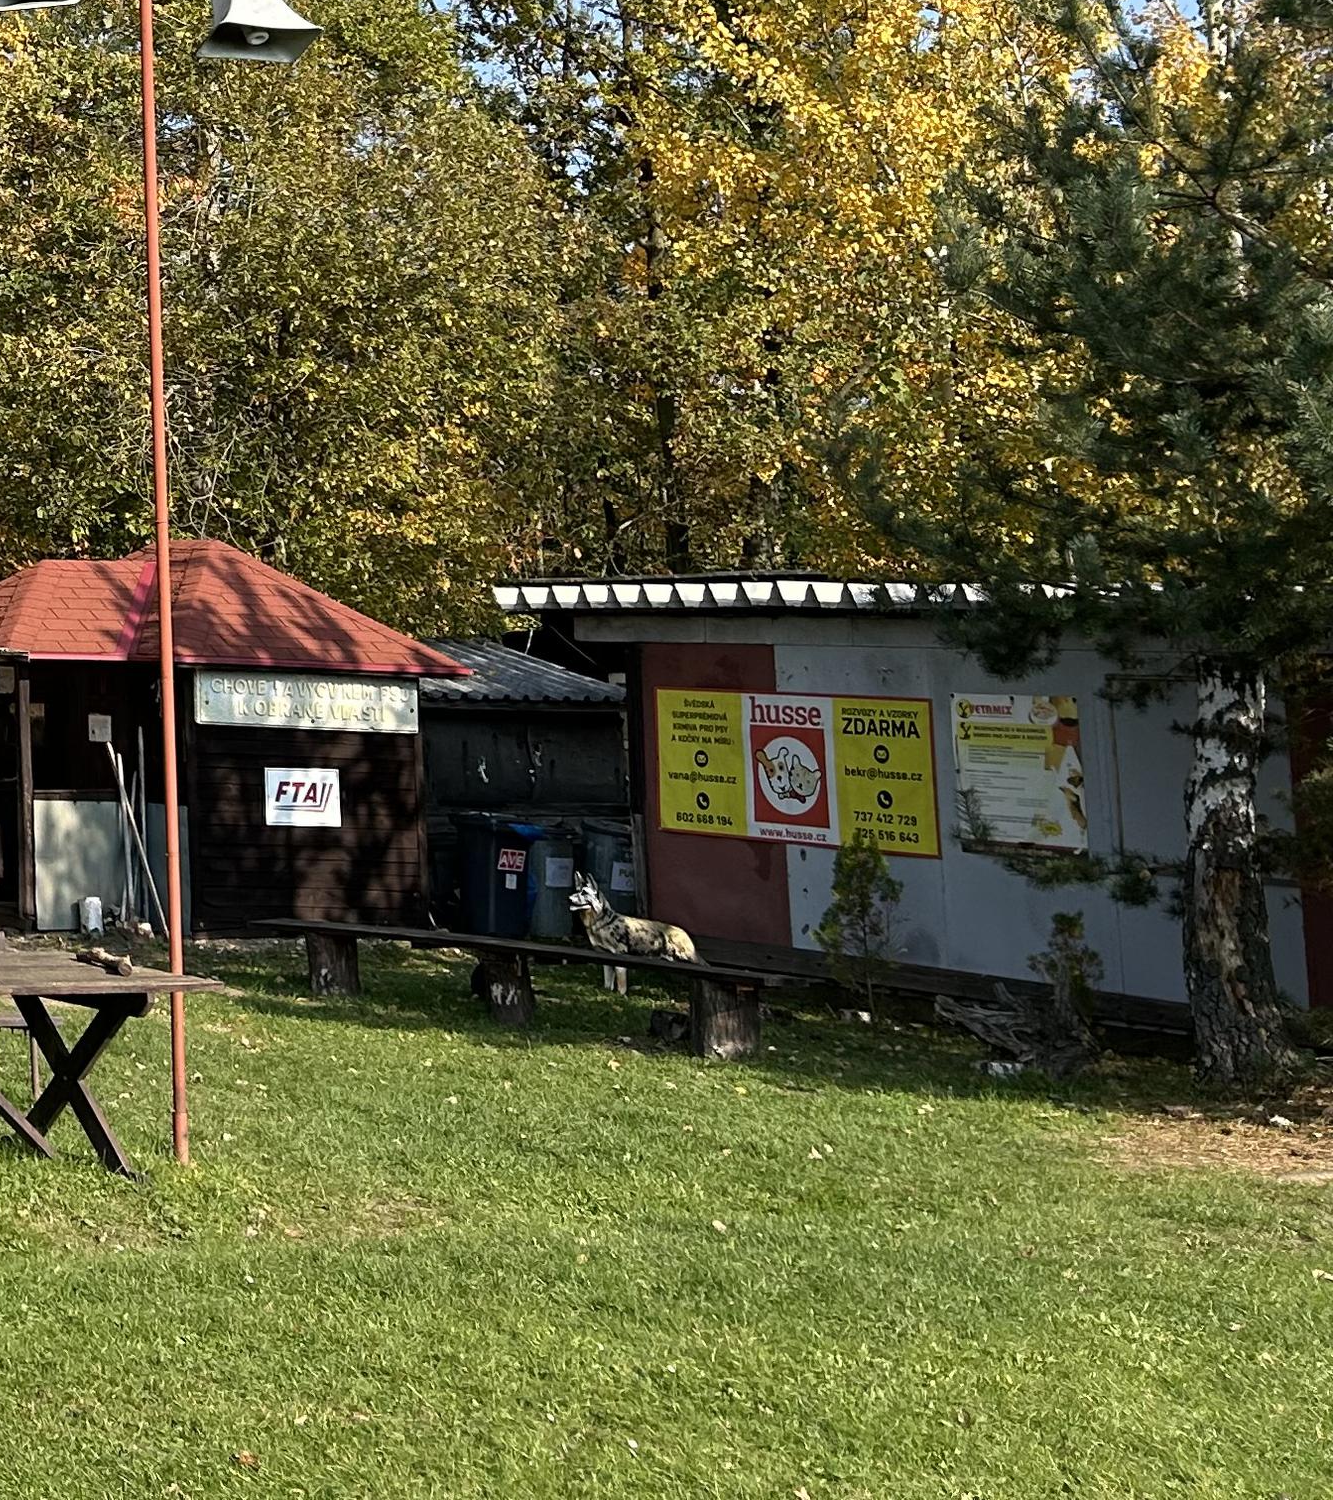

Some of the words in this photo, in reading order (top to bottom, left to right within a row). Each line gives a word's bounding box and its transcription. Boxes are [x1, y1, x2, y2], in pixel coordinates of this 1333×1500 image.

[749, 696, 822, 726] husse
[841, 707, 877, 717] ROZVOZY
[879, 709, 885, 718] A
[886, 709, 919, 720] VZORKY
[699, 724, 713, 733] PRO
[841, 717, 921, 739] ZDARMA
[701, 736, 712, 745] NA
[844, 765, 923, 782] bekr@husse.cz
[676, 811, 694, 823] 602
[716, 815, 734, 826] 194
[853, 811, 873, 823] 737
[876, 812, 894, 825] 412
[897, 814, 917, 827] 729
[899, 831, 920, 844] 643
[499, 854, 525, 868] AVE
